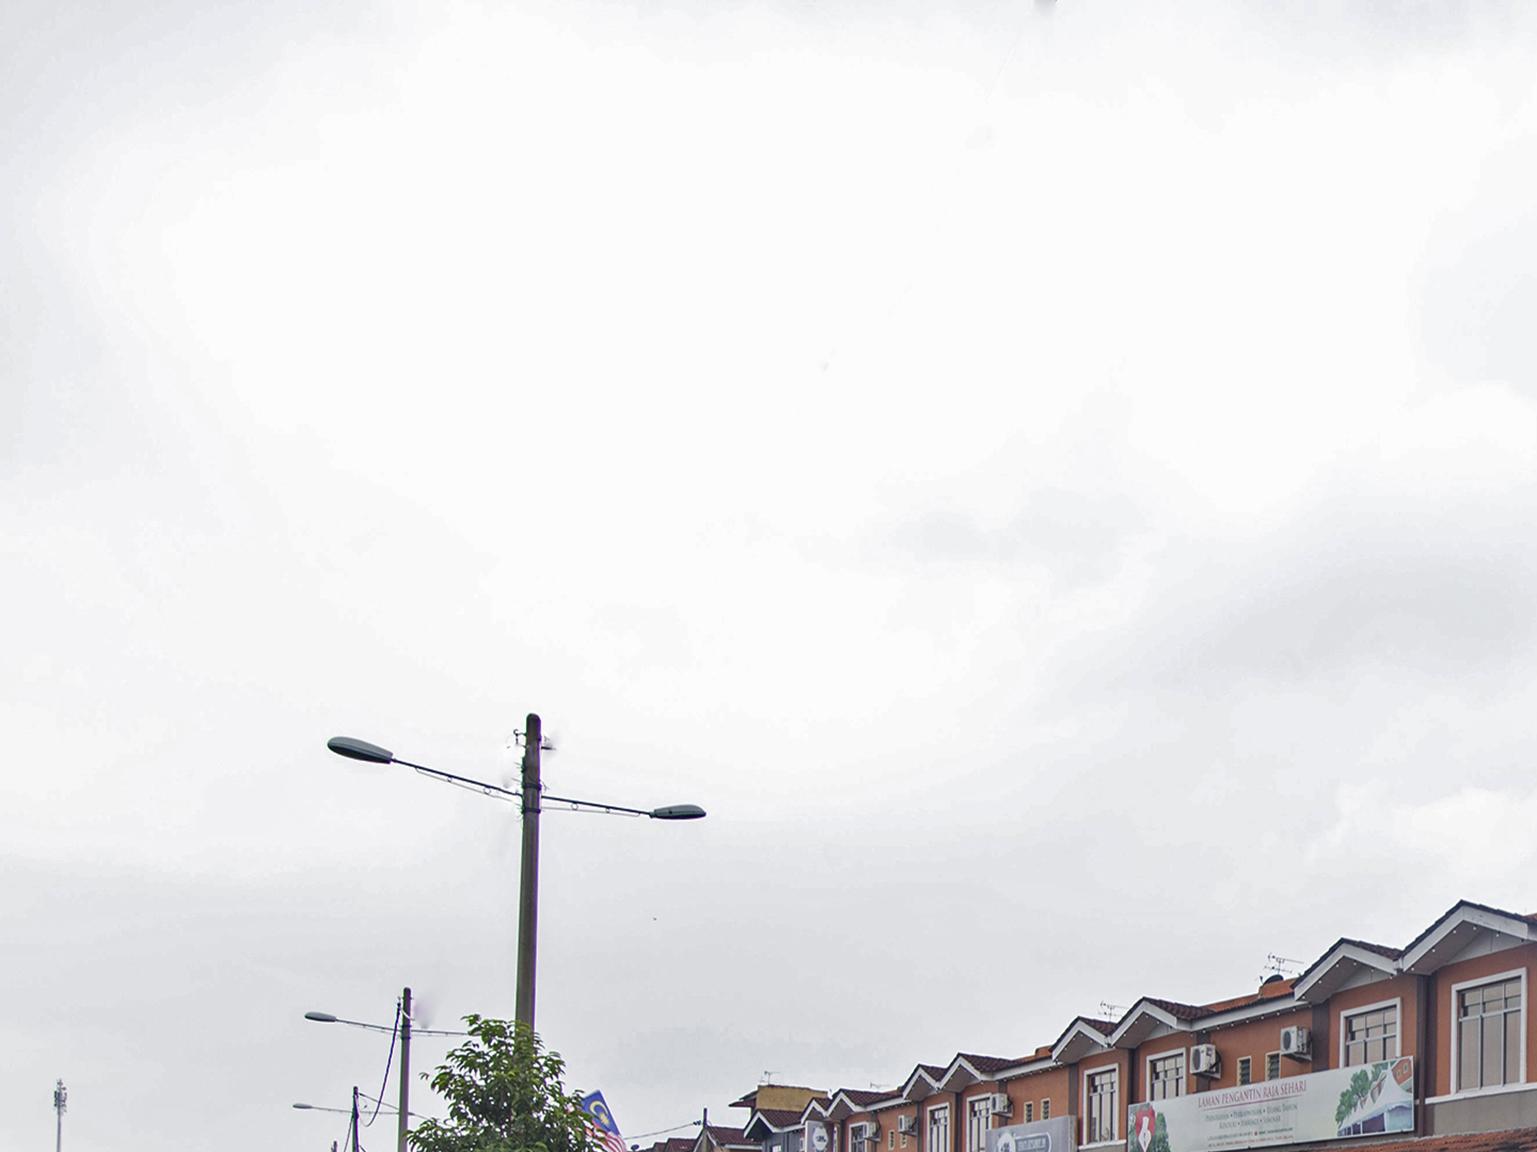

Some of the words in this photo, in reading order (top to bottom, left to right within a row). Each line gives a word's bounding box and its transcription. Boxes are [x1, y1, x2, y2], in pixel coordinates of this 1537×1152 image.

[1198, 1096, 1220, 1108] LAMAN
[1221, 1088, 1262, 1104] PENGANTIN
[1262, 1085, 1280, 1099] RAJA
[1280, 1079, 1307, 1096] SEHARI
